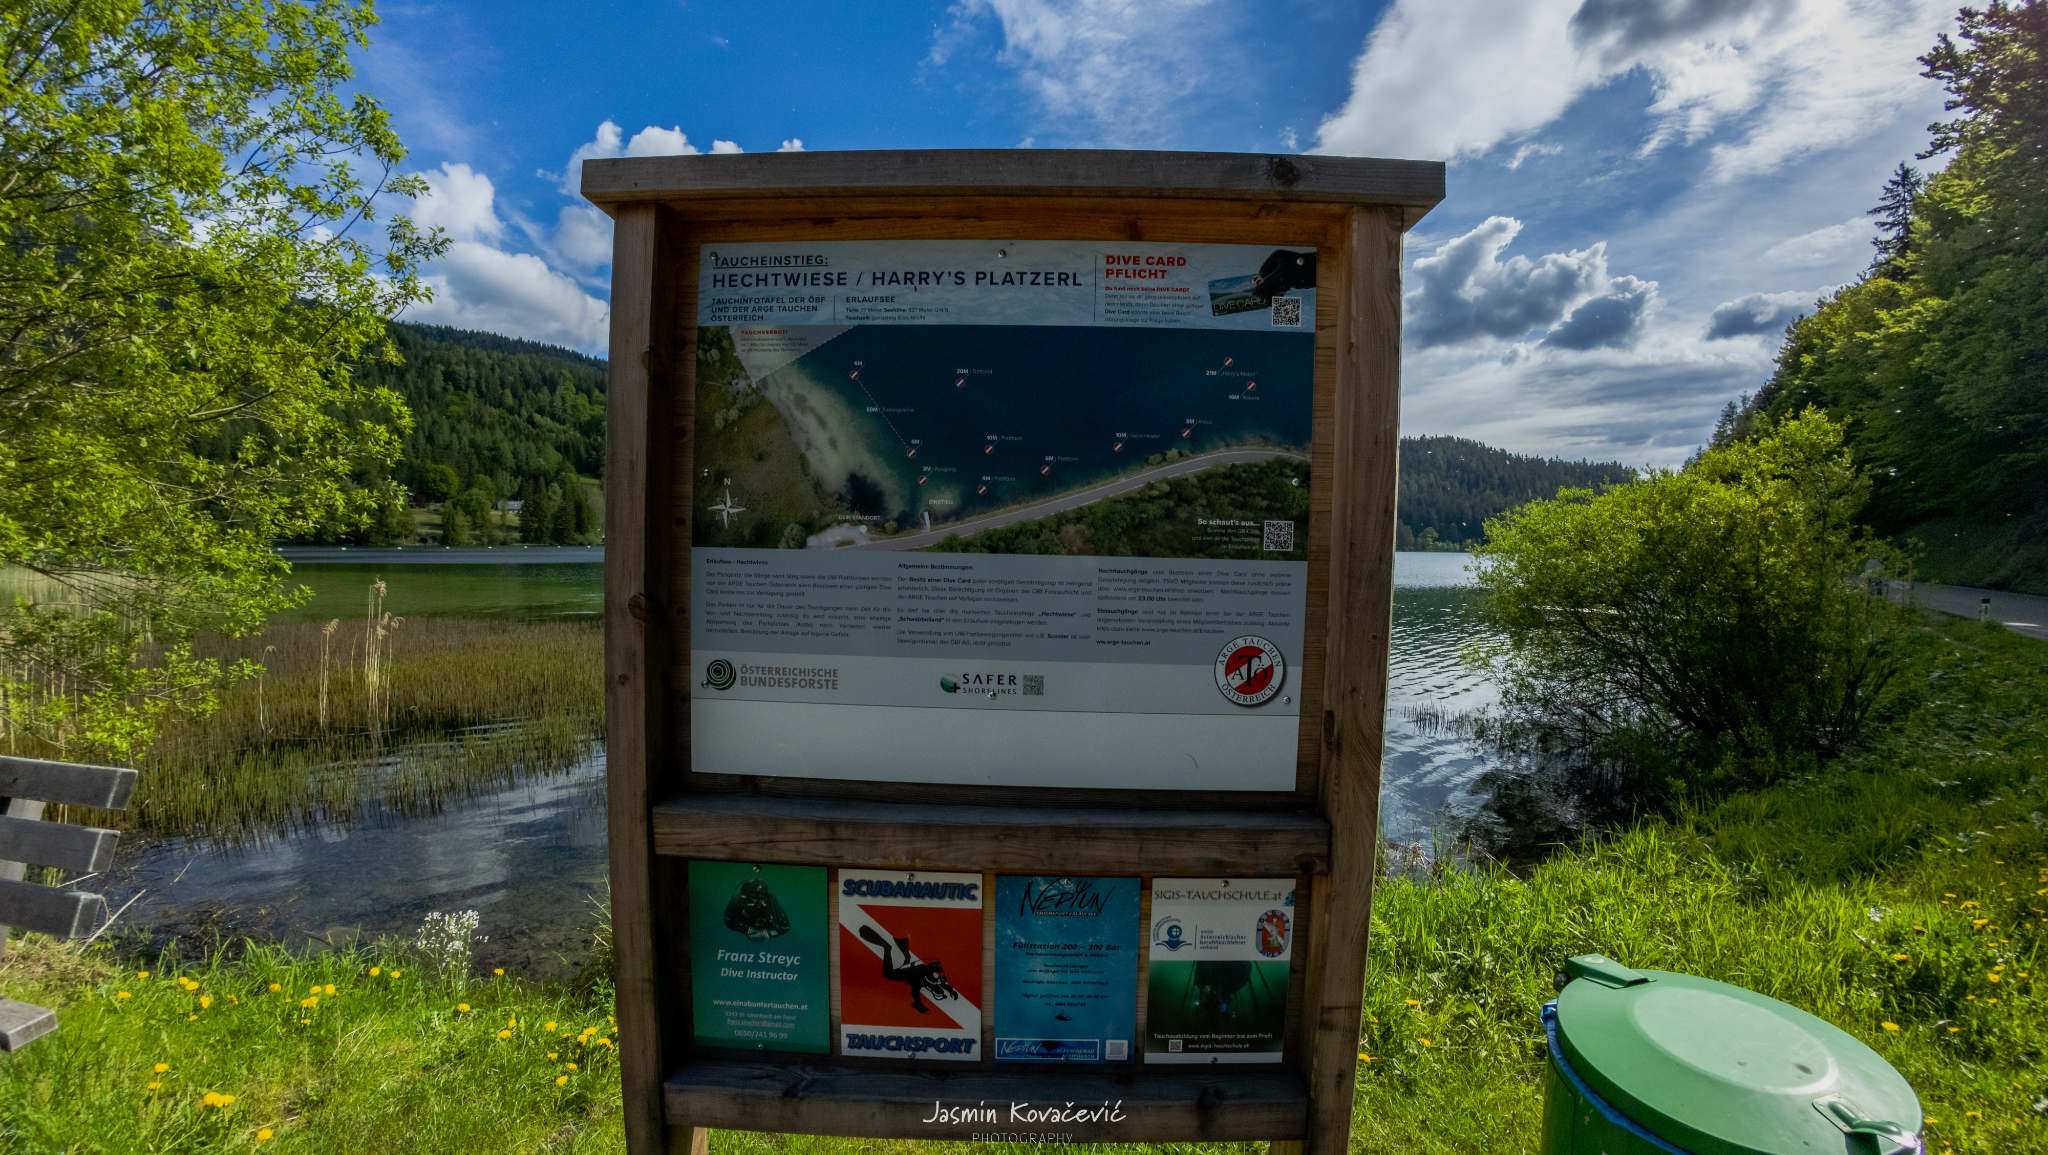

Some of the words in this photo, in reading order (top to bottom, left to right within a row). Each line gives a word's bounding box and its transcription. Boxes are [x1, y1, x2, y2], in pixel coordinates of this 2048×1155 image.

[713, 256, 828, 266] TAUCHEINSTIEG:
[1105, 255, 1141, 266] DIVE
[1146, 255, 1187, 267] CARD
[713, 272, 847, 288] HECHTWIESE
[856, 272, 863, 286] /
[975, 271, 1082, 287] PLATZERL
[1105, 268, 1168, 280] PFLICHT
[724, 478, 730, 486] N
[1219, 642, 1239, 666] ARGE
[1243, 638, 1281, 667] TAUCHEN
[740, 664, 838, 678] ÖSTERREICHISCHE
[740, 676, 838, 690] BUNDESFORSTE
[963, 673, 1017, 685] SAFER
[1222, 684, 1276, 703] ÖSTERREICH
[842, 879, 978, 900] SCUBANAUTIC
[1154, 890, 1282, 900] SIGIS-TAUCHSCHULE.at
[1013, 942, 1060, 950] Füllstation
[717, 949, 755, 963] Franz
[758, 952, 801, 967] Streyc
[721, 968, 744, 978] Dive
[746, 969, 798, 981] Instructor
[712, 999, 808, 1010] www.einabuntertauchen.at
[734, 1030, 766, 1038] 0650/241
[846, 1034, 976, 1054] TAUCHSPORT
